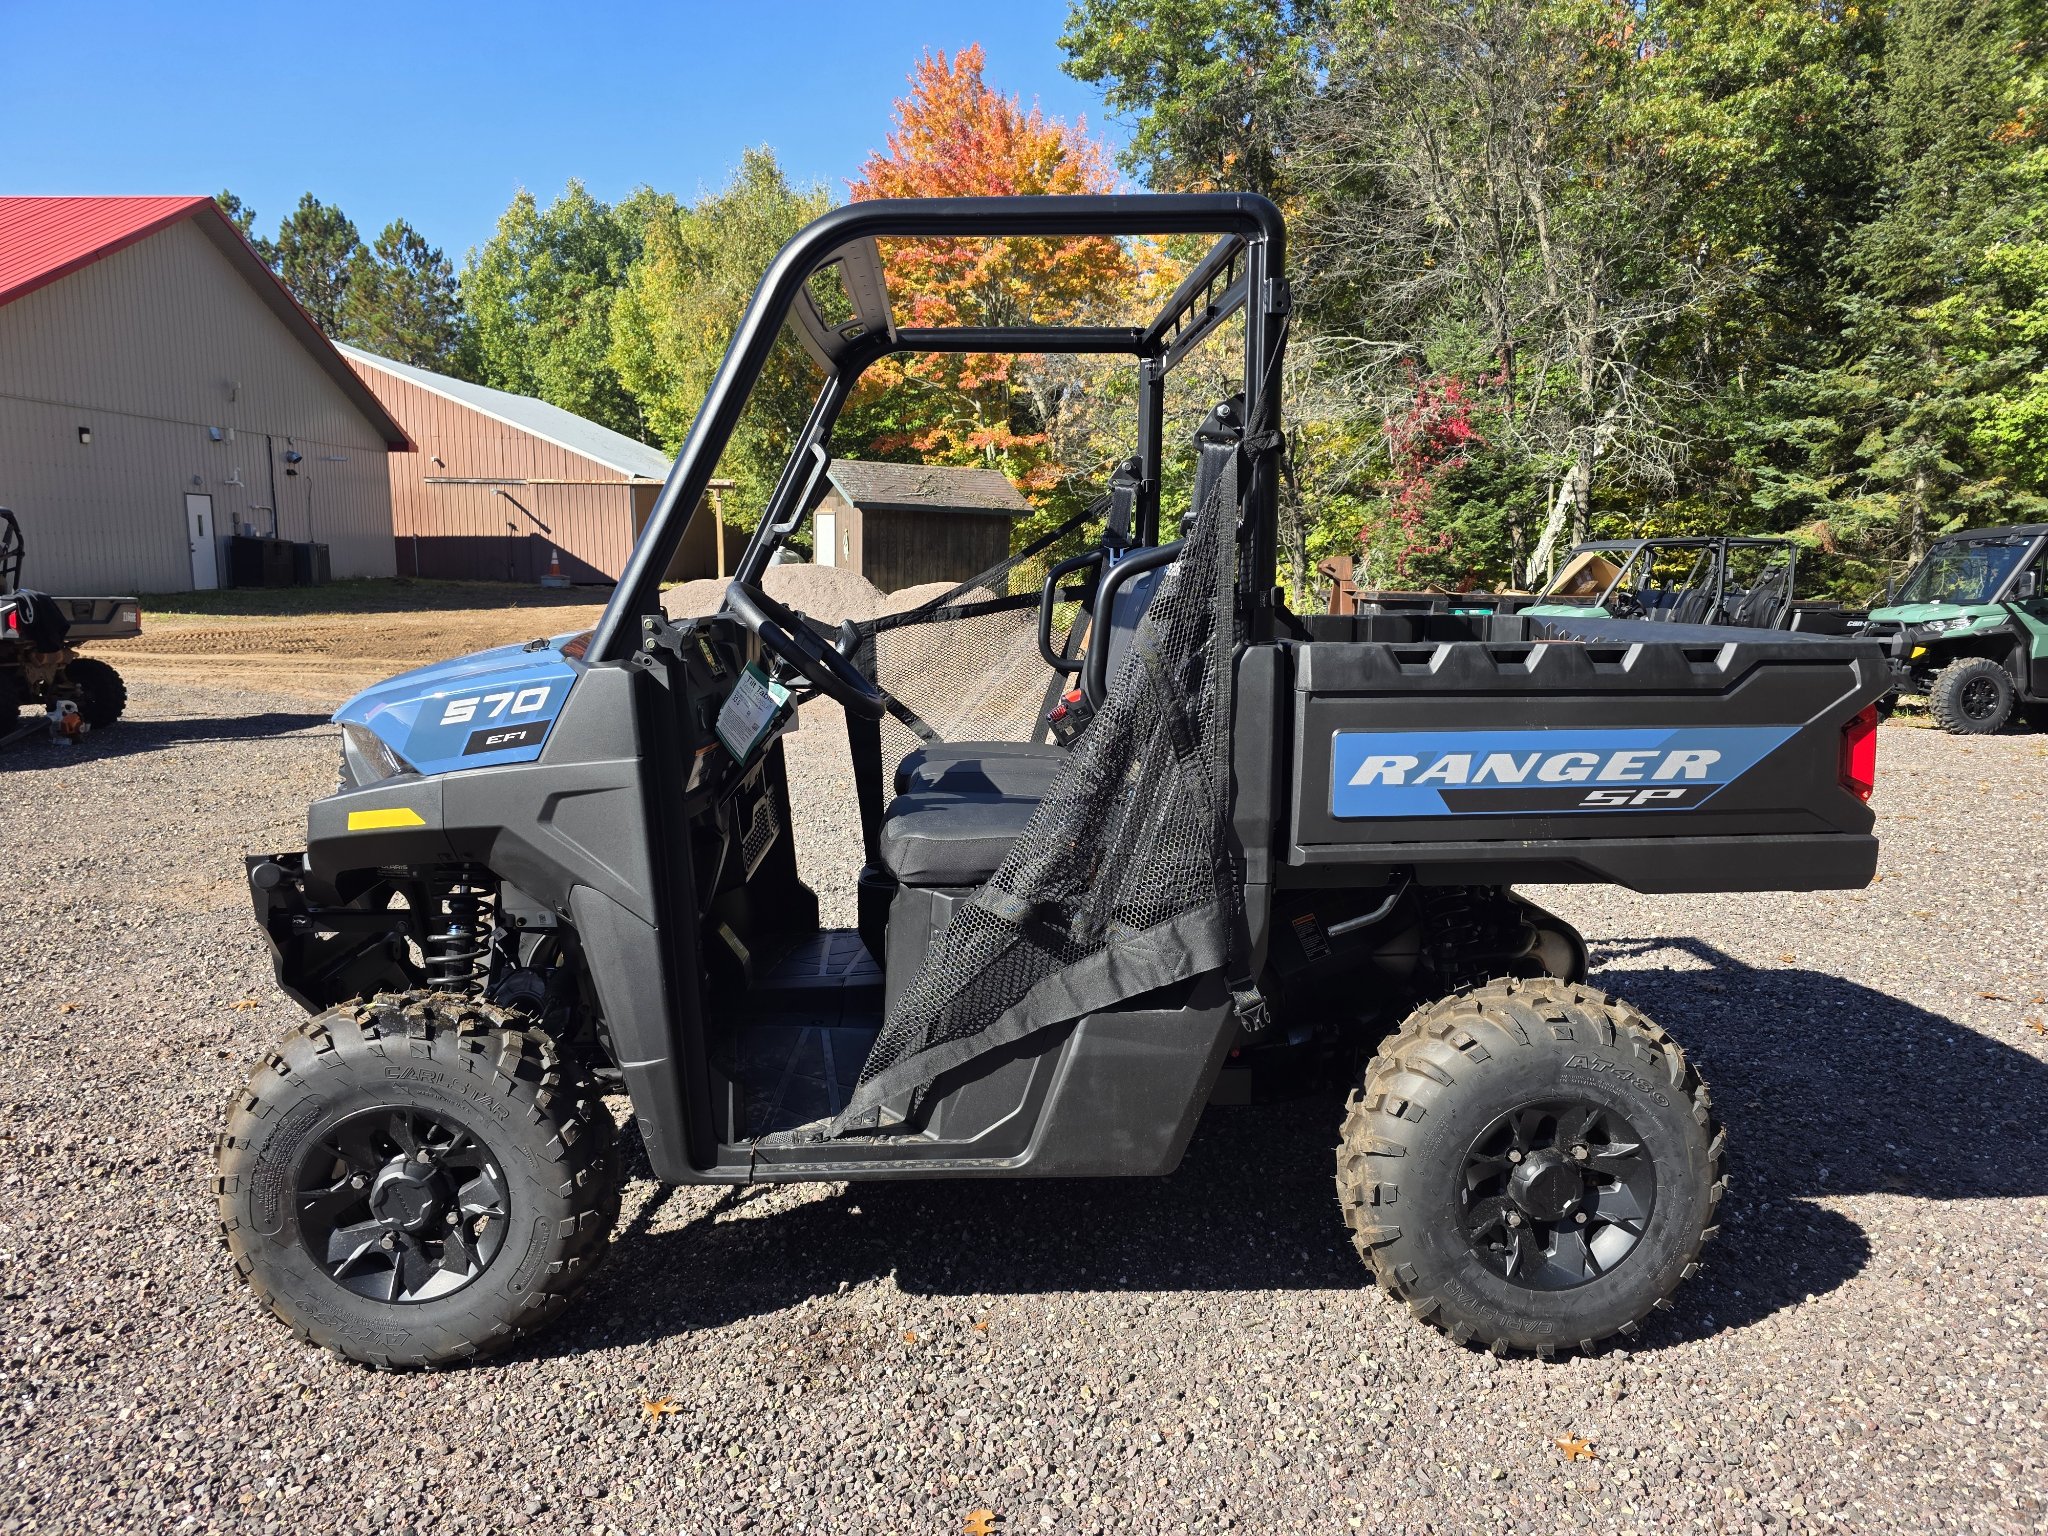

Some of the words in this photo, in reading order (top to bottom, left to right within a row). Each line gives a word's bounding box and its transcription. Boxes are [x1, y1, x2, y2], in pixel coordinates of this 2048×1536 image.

[745, 675, 757, 689] Tilt
[439, 686, 551, 726] 570
[485, 730, 527, 746] EFI
[1348, 749, 1722, 786] RANGER
[1578, 788, 1688, 806] SP
[384, 1065, 511, 1122] CARLSTAR
[1563, 1053, 1671, 1108] AT489
